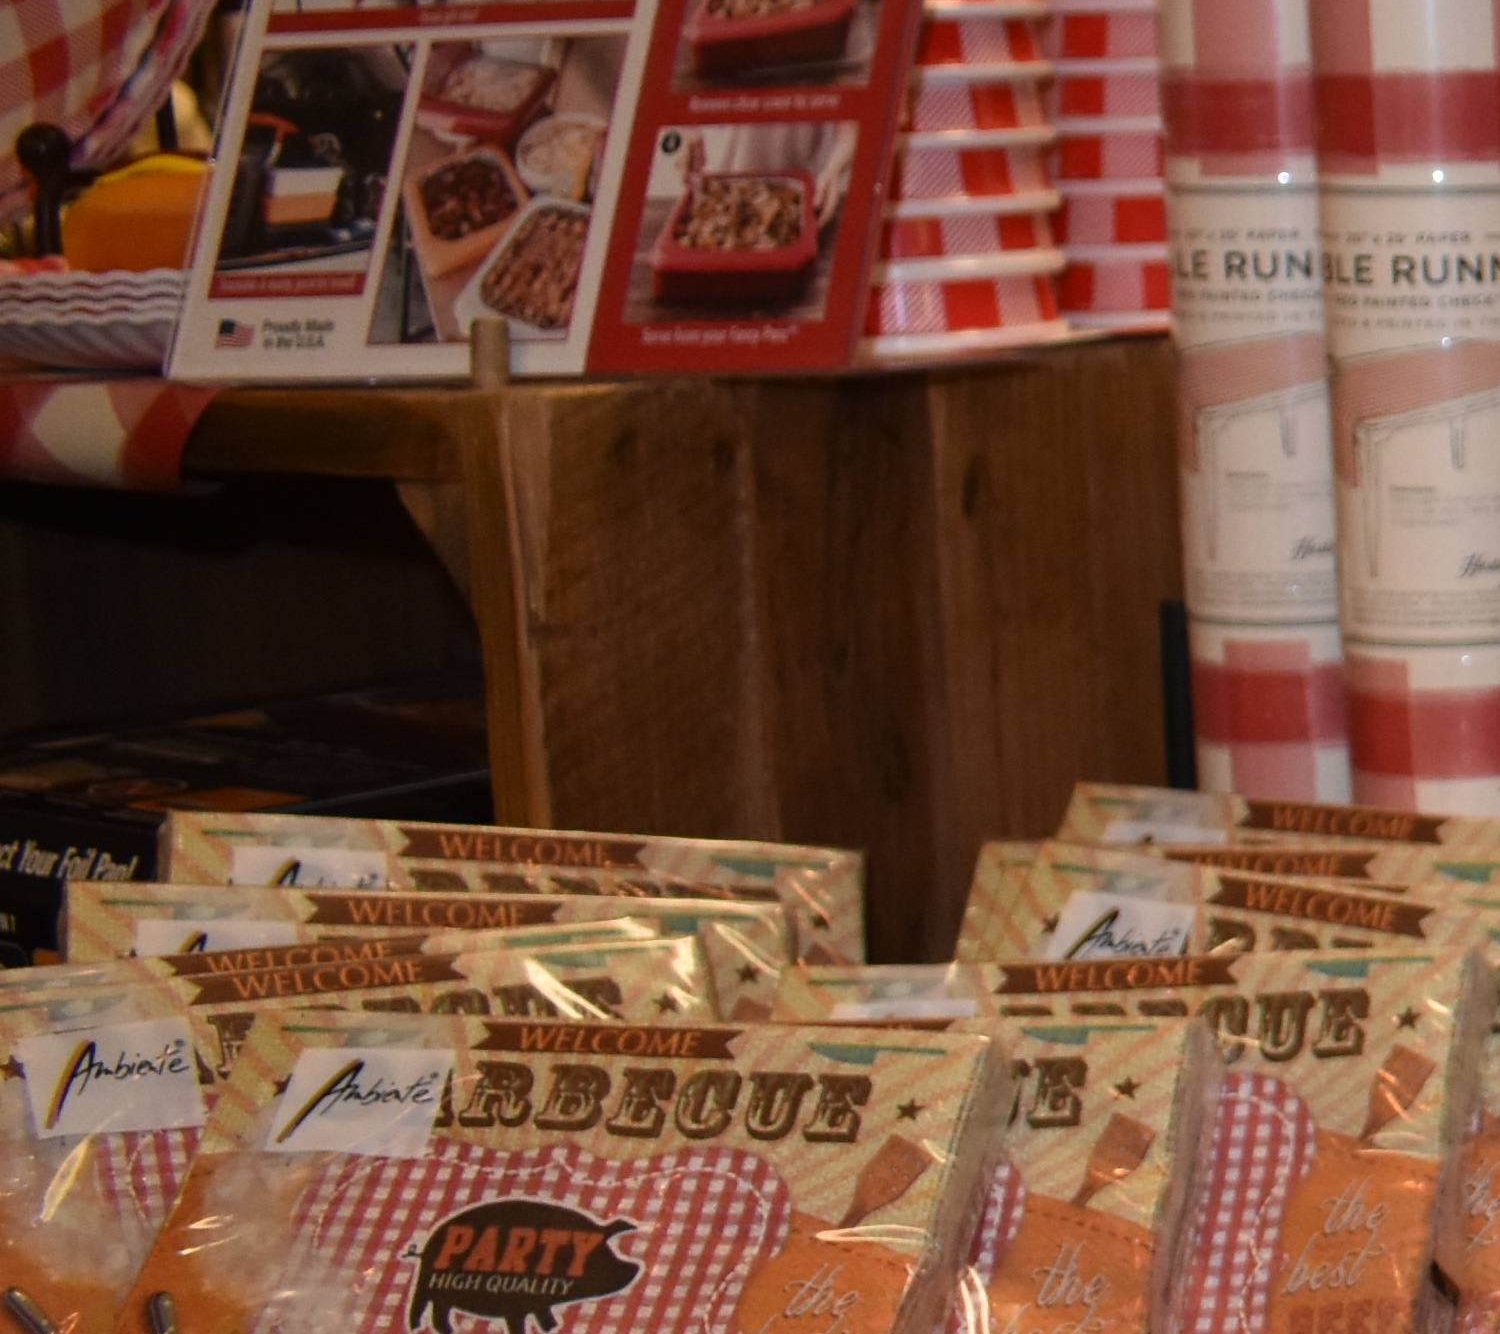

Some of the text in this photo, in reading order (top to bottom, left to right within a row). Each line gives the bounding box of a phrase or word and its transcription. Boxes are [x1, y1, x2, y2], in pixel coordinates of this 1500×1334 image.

[1272, 806, 1415, 838] WELCOME
[440, 834, 612, 867] WELCOME
[348, 899, 525, 928] WELCOME
[1245, 882, 1399, 932] WELCOME
[233, 960, 424, 1000] WELCOME
[1034, 961, 1202, 992] WELCOME
[519, 1025, 703, 1056] WELCOME
[1324, 1177, 1387, 1238] the
[435, 1225, 605, 1277] PARTY
[429, 1272, 574, 1296] HIGH QUALITY
[1282, 1244, 1385, 1297] best
[783, 1264, 860, 1322] the
